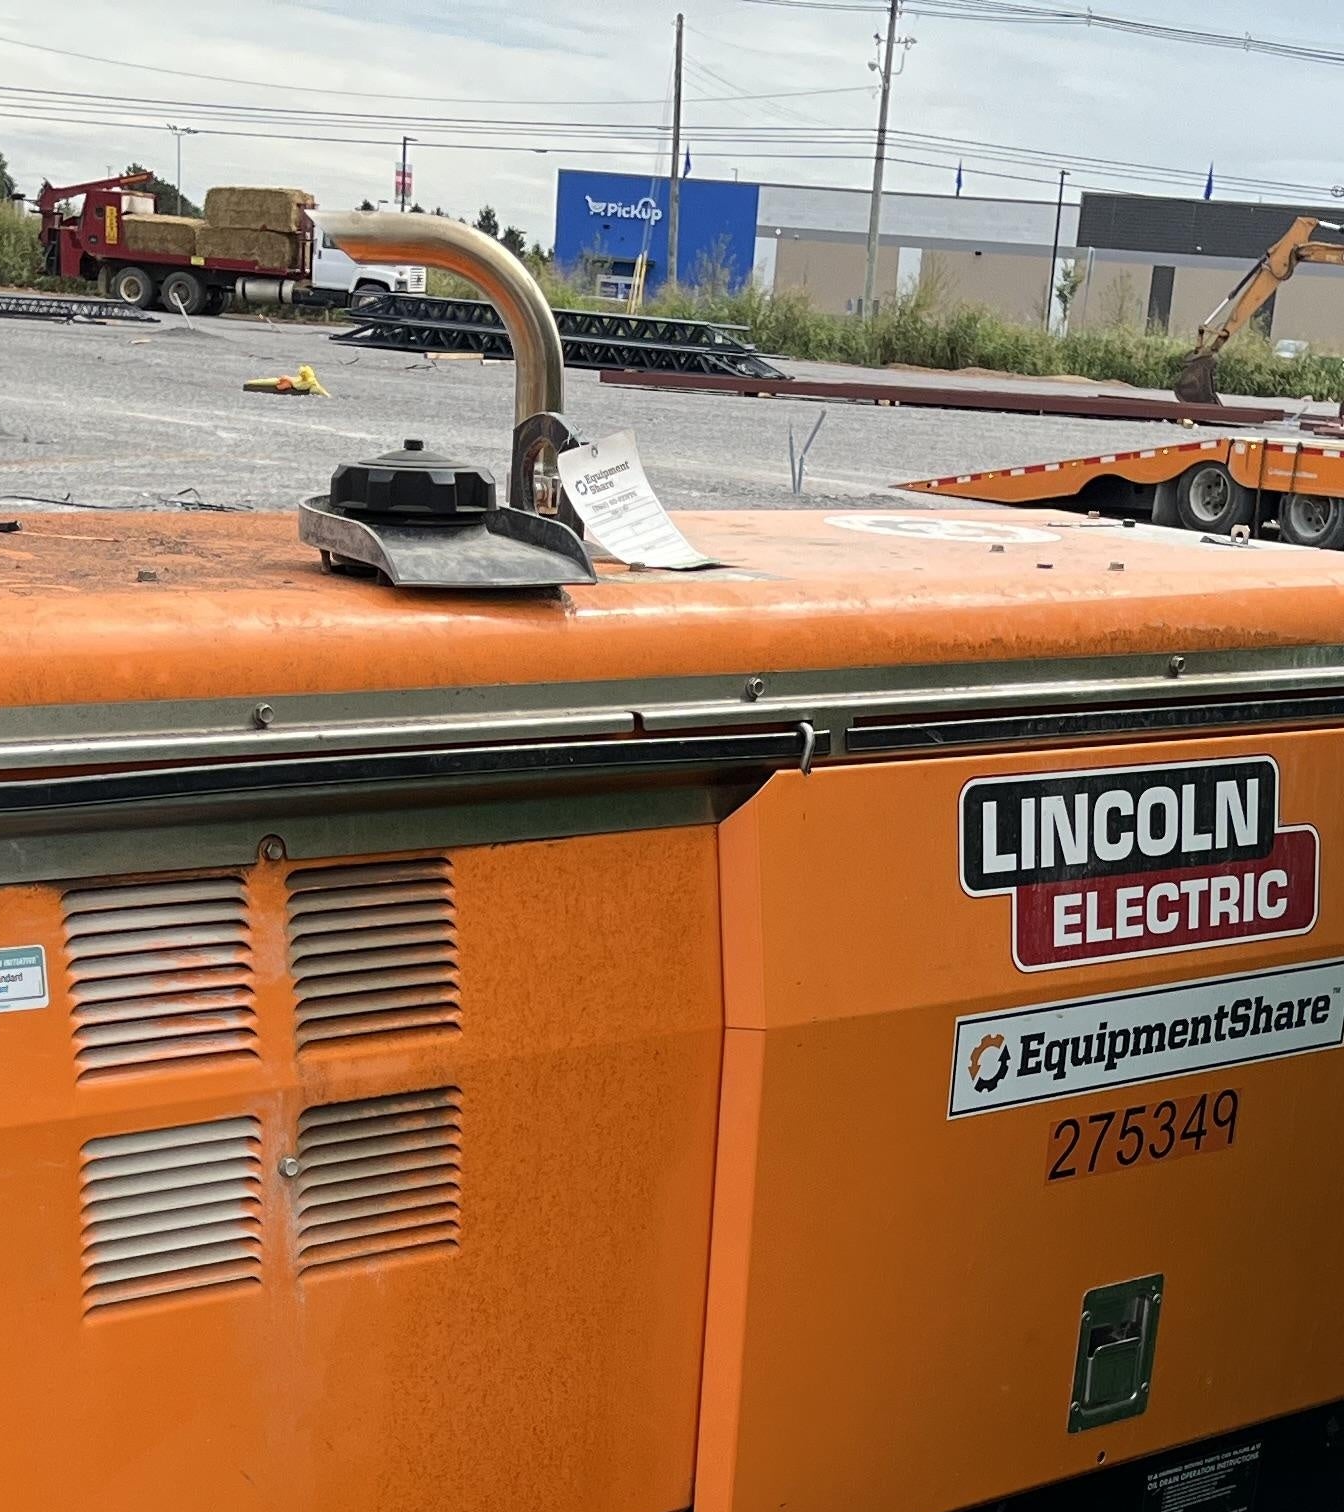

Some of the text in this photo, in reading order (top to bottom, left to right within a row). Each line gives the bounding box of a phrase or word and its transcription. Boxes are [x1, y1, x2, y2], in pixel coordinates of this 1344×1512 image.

[583, 461, 630, 485] Equipment
[588, 480, 614, 495] Share
[982, 778, 1260, 874] LINCOLN
[1053, 869, 1288, 947] ELECTRIC
[1016, 993, 1331, 1081] EquipmentShare
[1047, 1089, 1239, 1181] 275349
[1159, 1475, 1180, 1487] DRAIN
[1180, 1465, 1216, 1480] OPERATION
[1217, 1451, 1259, 1470] INSTRUCTIONS
